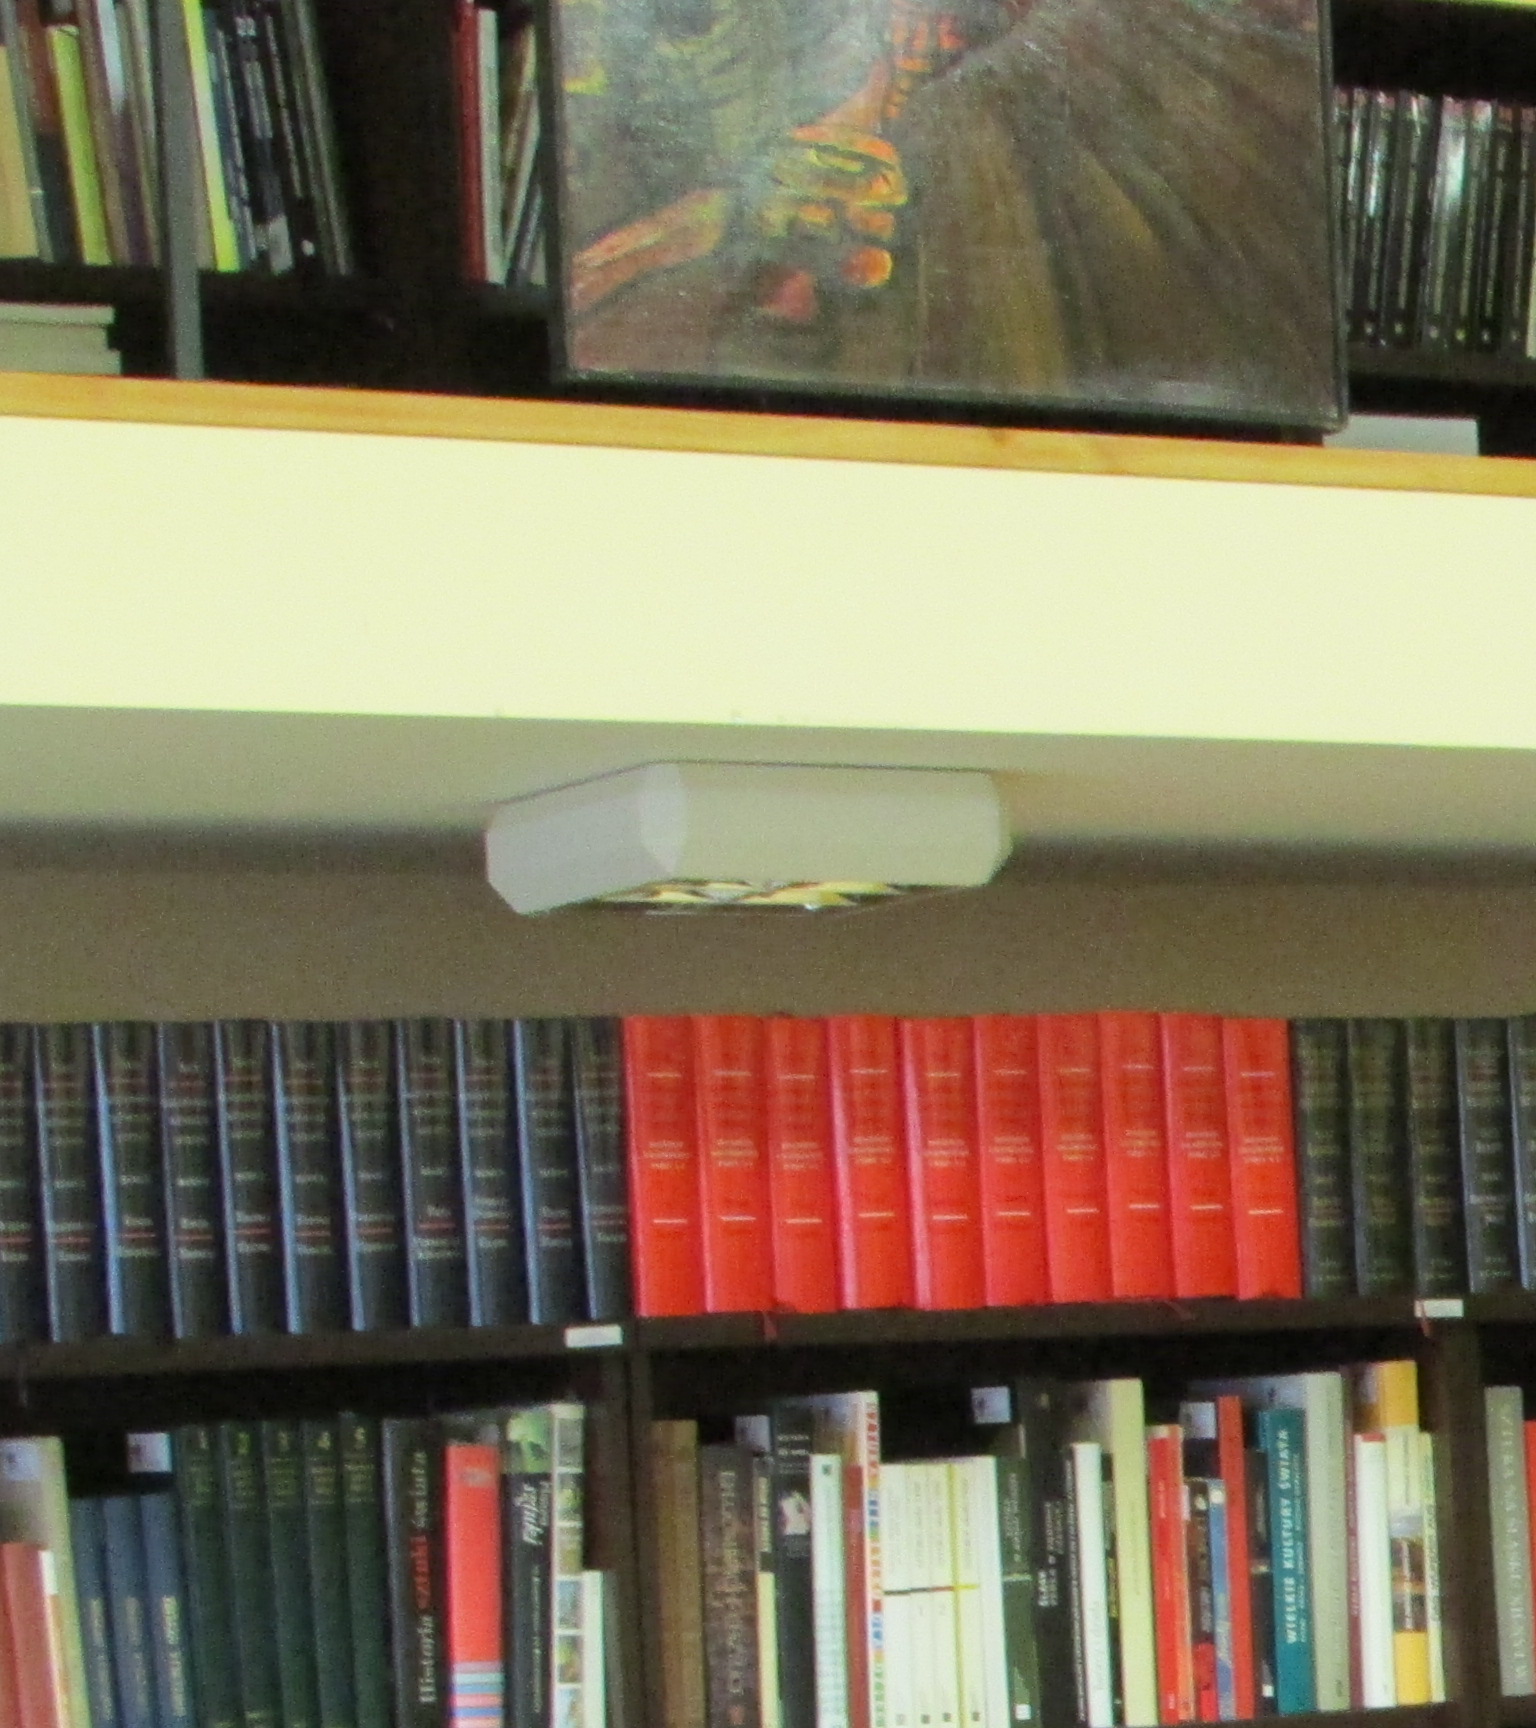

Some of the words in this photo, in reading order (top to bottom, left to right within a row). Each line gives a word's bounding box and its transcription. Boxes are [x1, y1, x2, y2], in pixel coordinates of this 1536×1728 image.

[411, 1450, 428, 1530] świata
[1276, 1429, 1292, 1490] ŚWIATA
[1279, 1498, 1295, 1570] KULTURY
[410, 1535, 431, 1610] sztuki
[1282, 1577, 1298, 1644] WIELKIE
[418, 1615, 437, 1704] Historia
